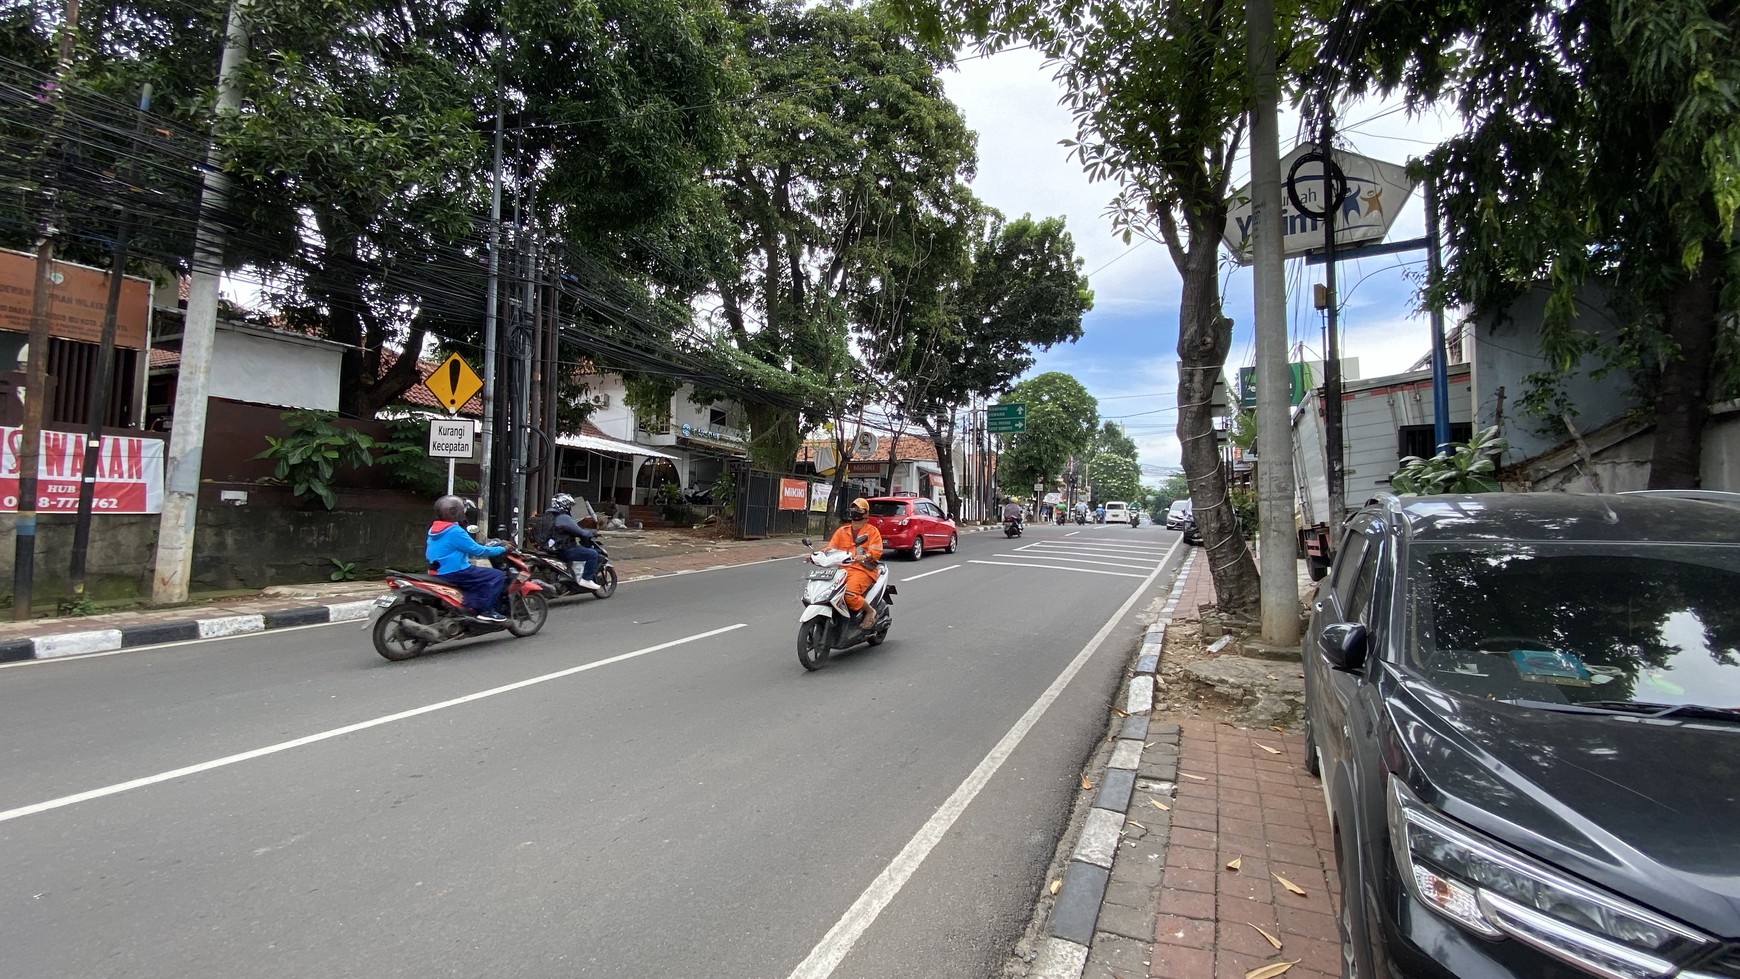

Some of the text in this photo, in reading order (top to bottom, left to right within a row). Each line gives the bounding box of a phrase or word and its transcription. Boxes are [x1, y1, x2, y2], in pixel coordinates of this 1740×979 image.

[1235, 209, 1318, 242] Yim
[438, 426, 466, 439] Kurangi
[432, 441, 470, 454] Kecepatan
[47, 484, 76, 493] HUB
